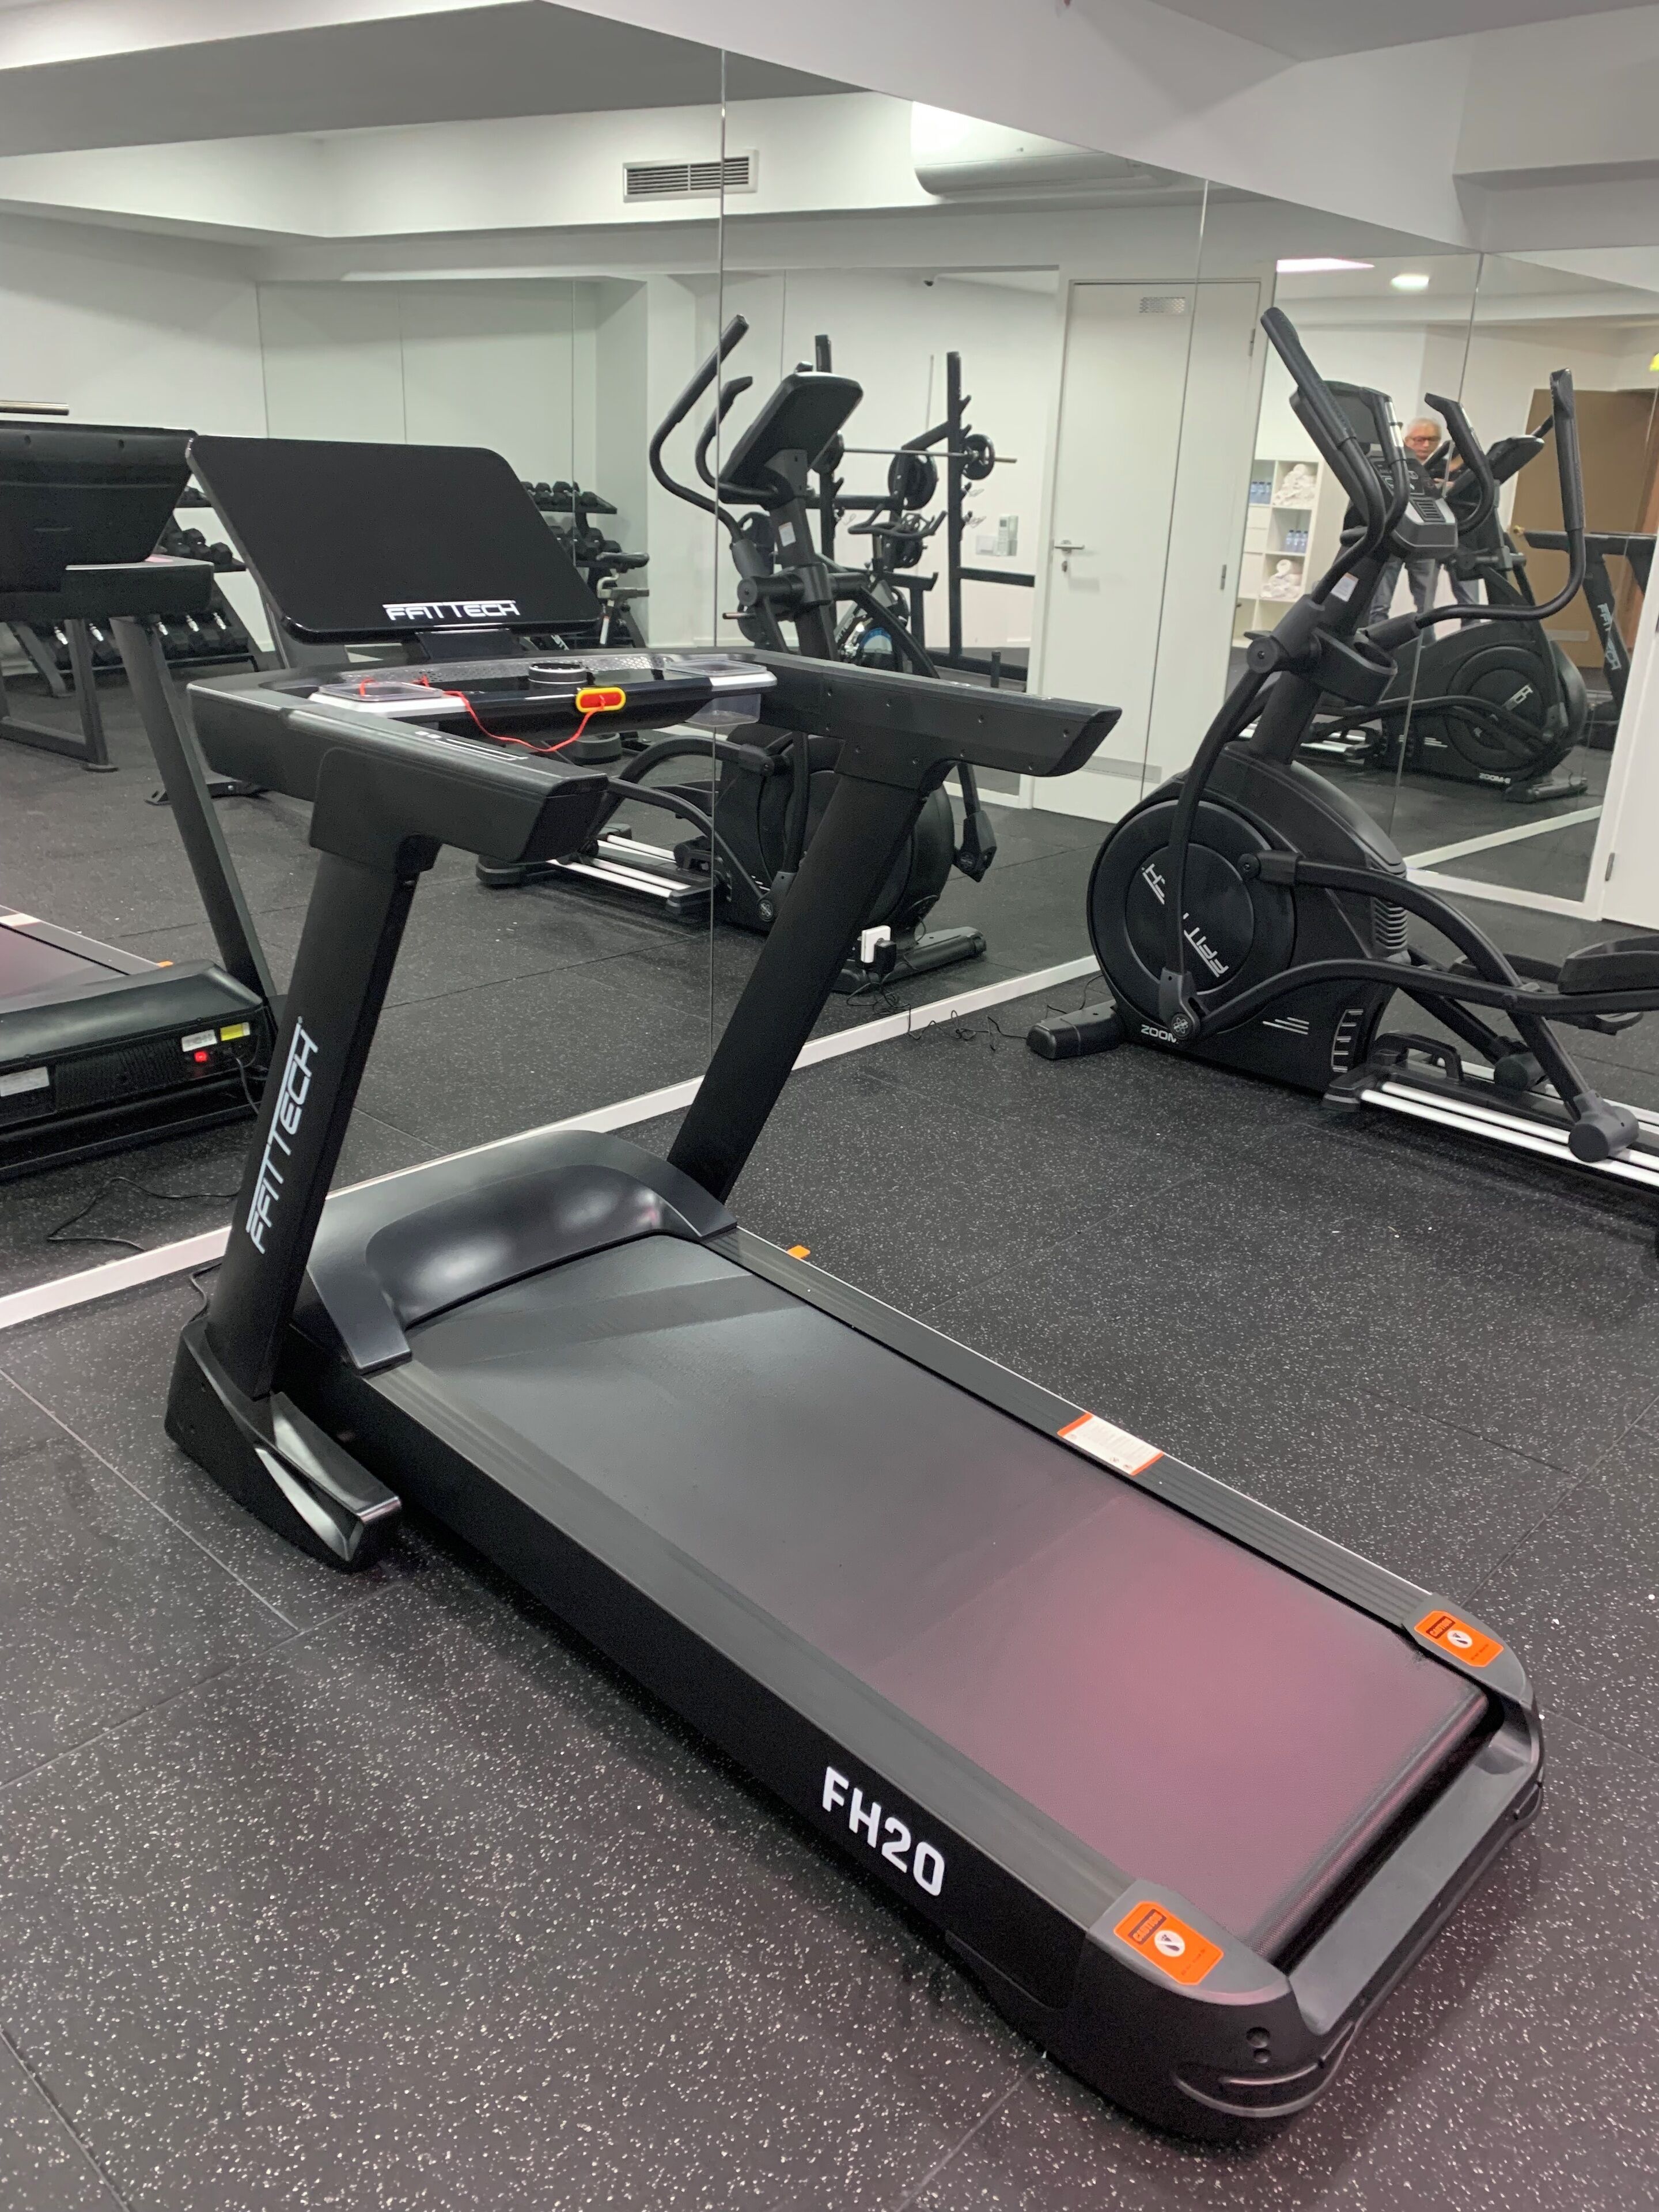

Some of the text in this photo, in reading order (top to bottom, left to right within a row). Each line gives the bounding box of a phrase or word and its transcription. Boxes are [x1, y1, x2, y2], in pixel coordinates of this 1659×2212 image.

[382, 600, 520, 620] FFITTECH
[245, 1016, 319, 1254] FFITTECH
[822, 1766, 945, 1896] FH20
